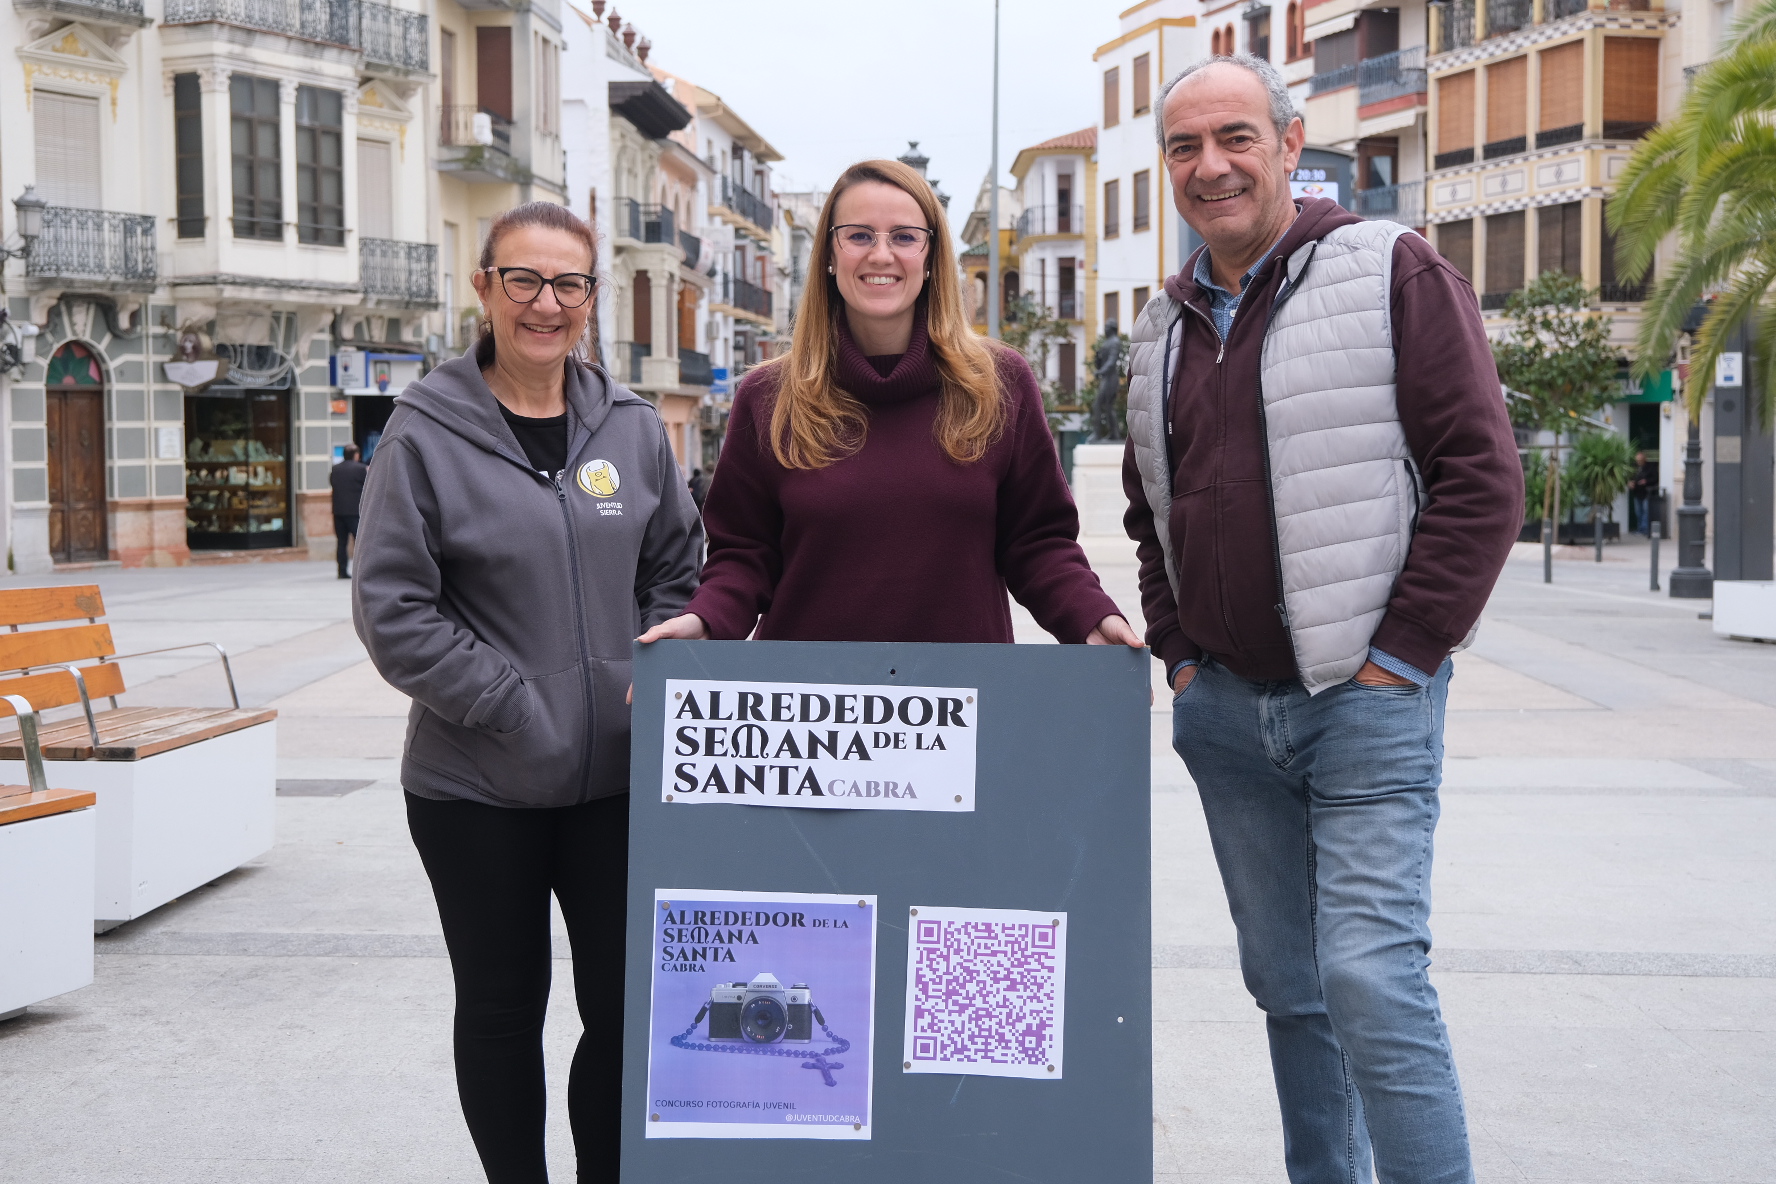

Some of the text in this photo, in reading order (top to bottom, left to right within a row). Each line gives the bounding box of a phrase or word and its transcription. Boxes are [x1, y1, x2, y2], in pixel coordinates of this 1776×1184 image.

[673, 689, 970, 728] ALREDEDOR
[674, 723, 947, 761] SEMANA DE LA
[673, 762, 918, 799] SANTA CABRA
[662, 909, 849, 929] ALREDEDOR DE LA
[662, 926, 760, 945] SEMANA
[661, 945, 737, 963] SANTA
[661, 962, 706, 973] CABRA
[654, 1099, 797, 1110] CONCURSO FOTOGRAFÍA JUVENIL
[785, 1113, 861, 1123] @JUVENTUDCABRA
